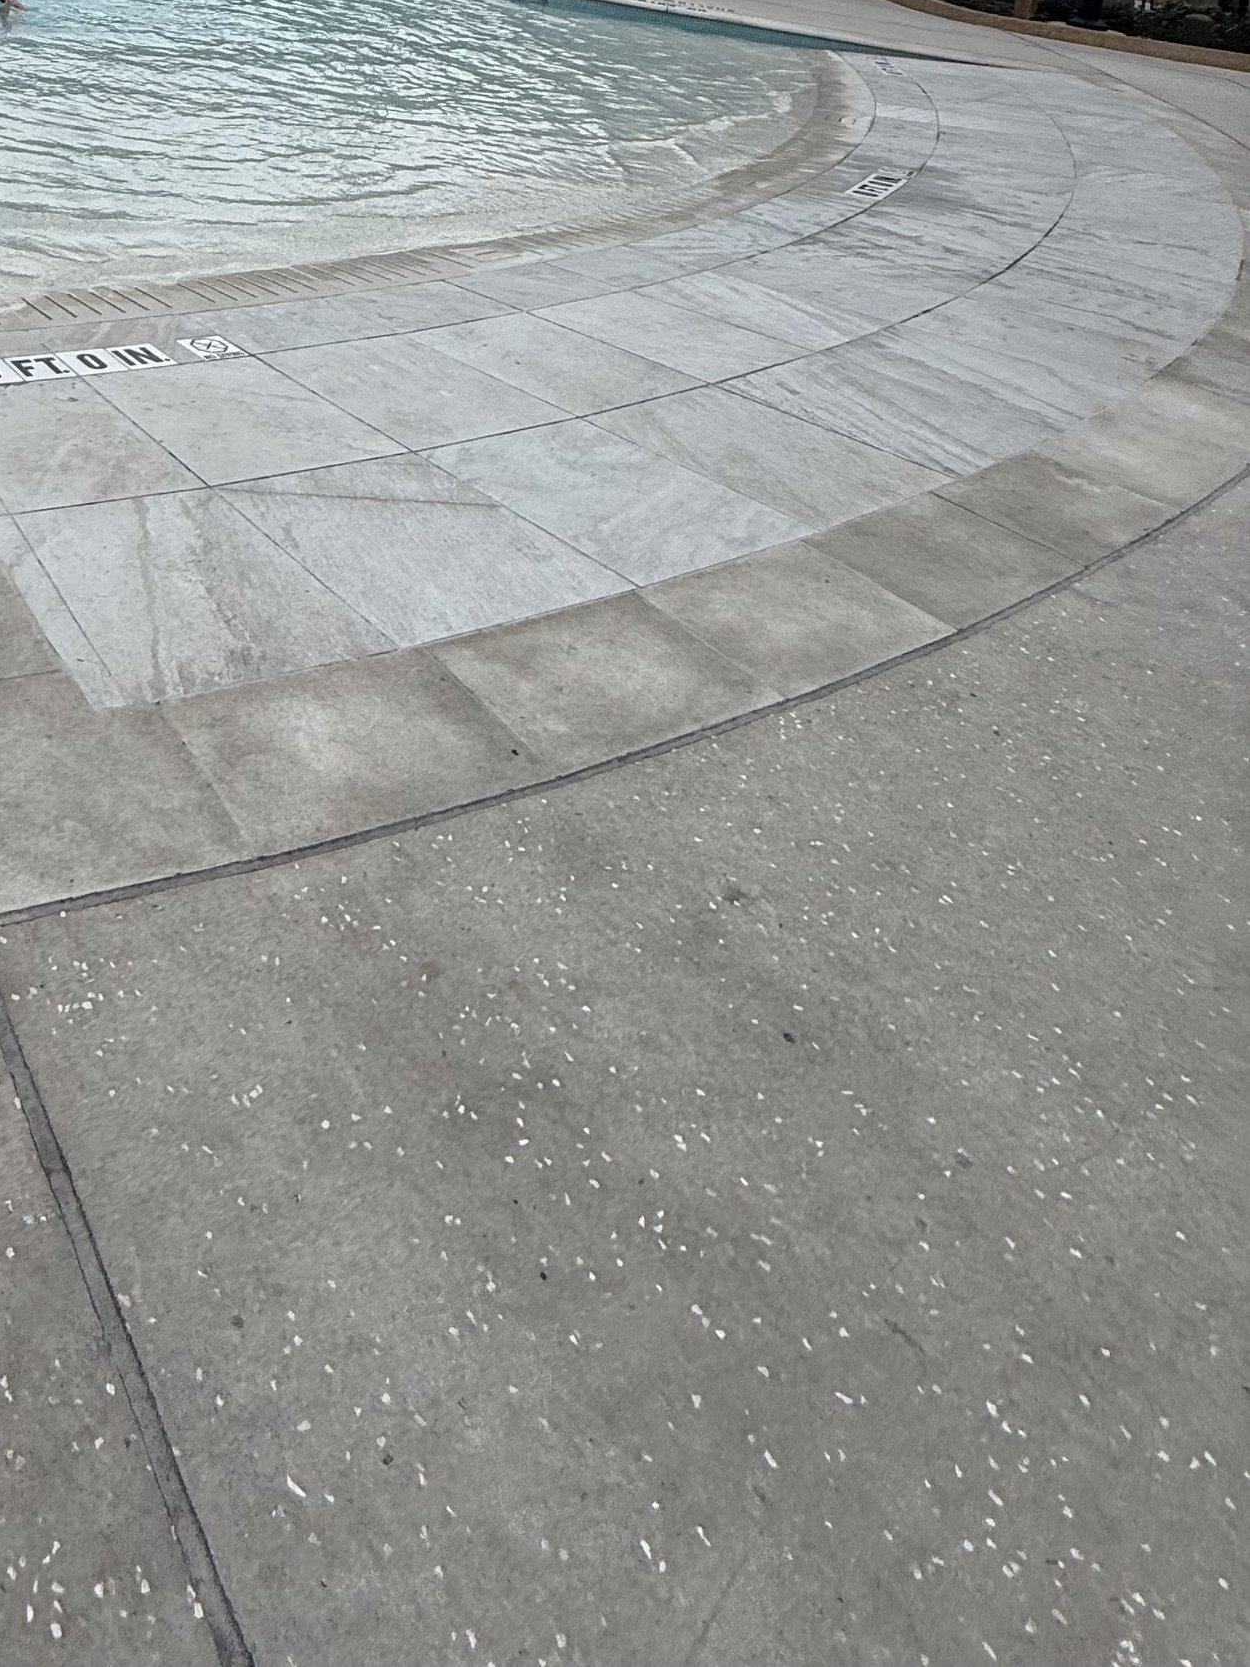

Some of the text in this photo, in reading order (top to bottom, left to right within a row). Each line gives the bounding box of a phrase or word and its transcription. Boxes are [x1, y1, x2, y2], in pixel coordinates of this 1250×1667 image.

[11, 356, 70, 377] FT.
[76, 353, 108, 370] 0
[111, 346, 171, 366] IN.
